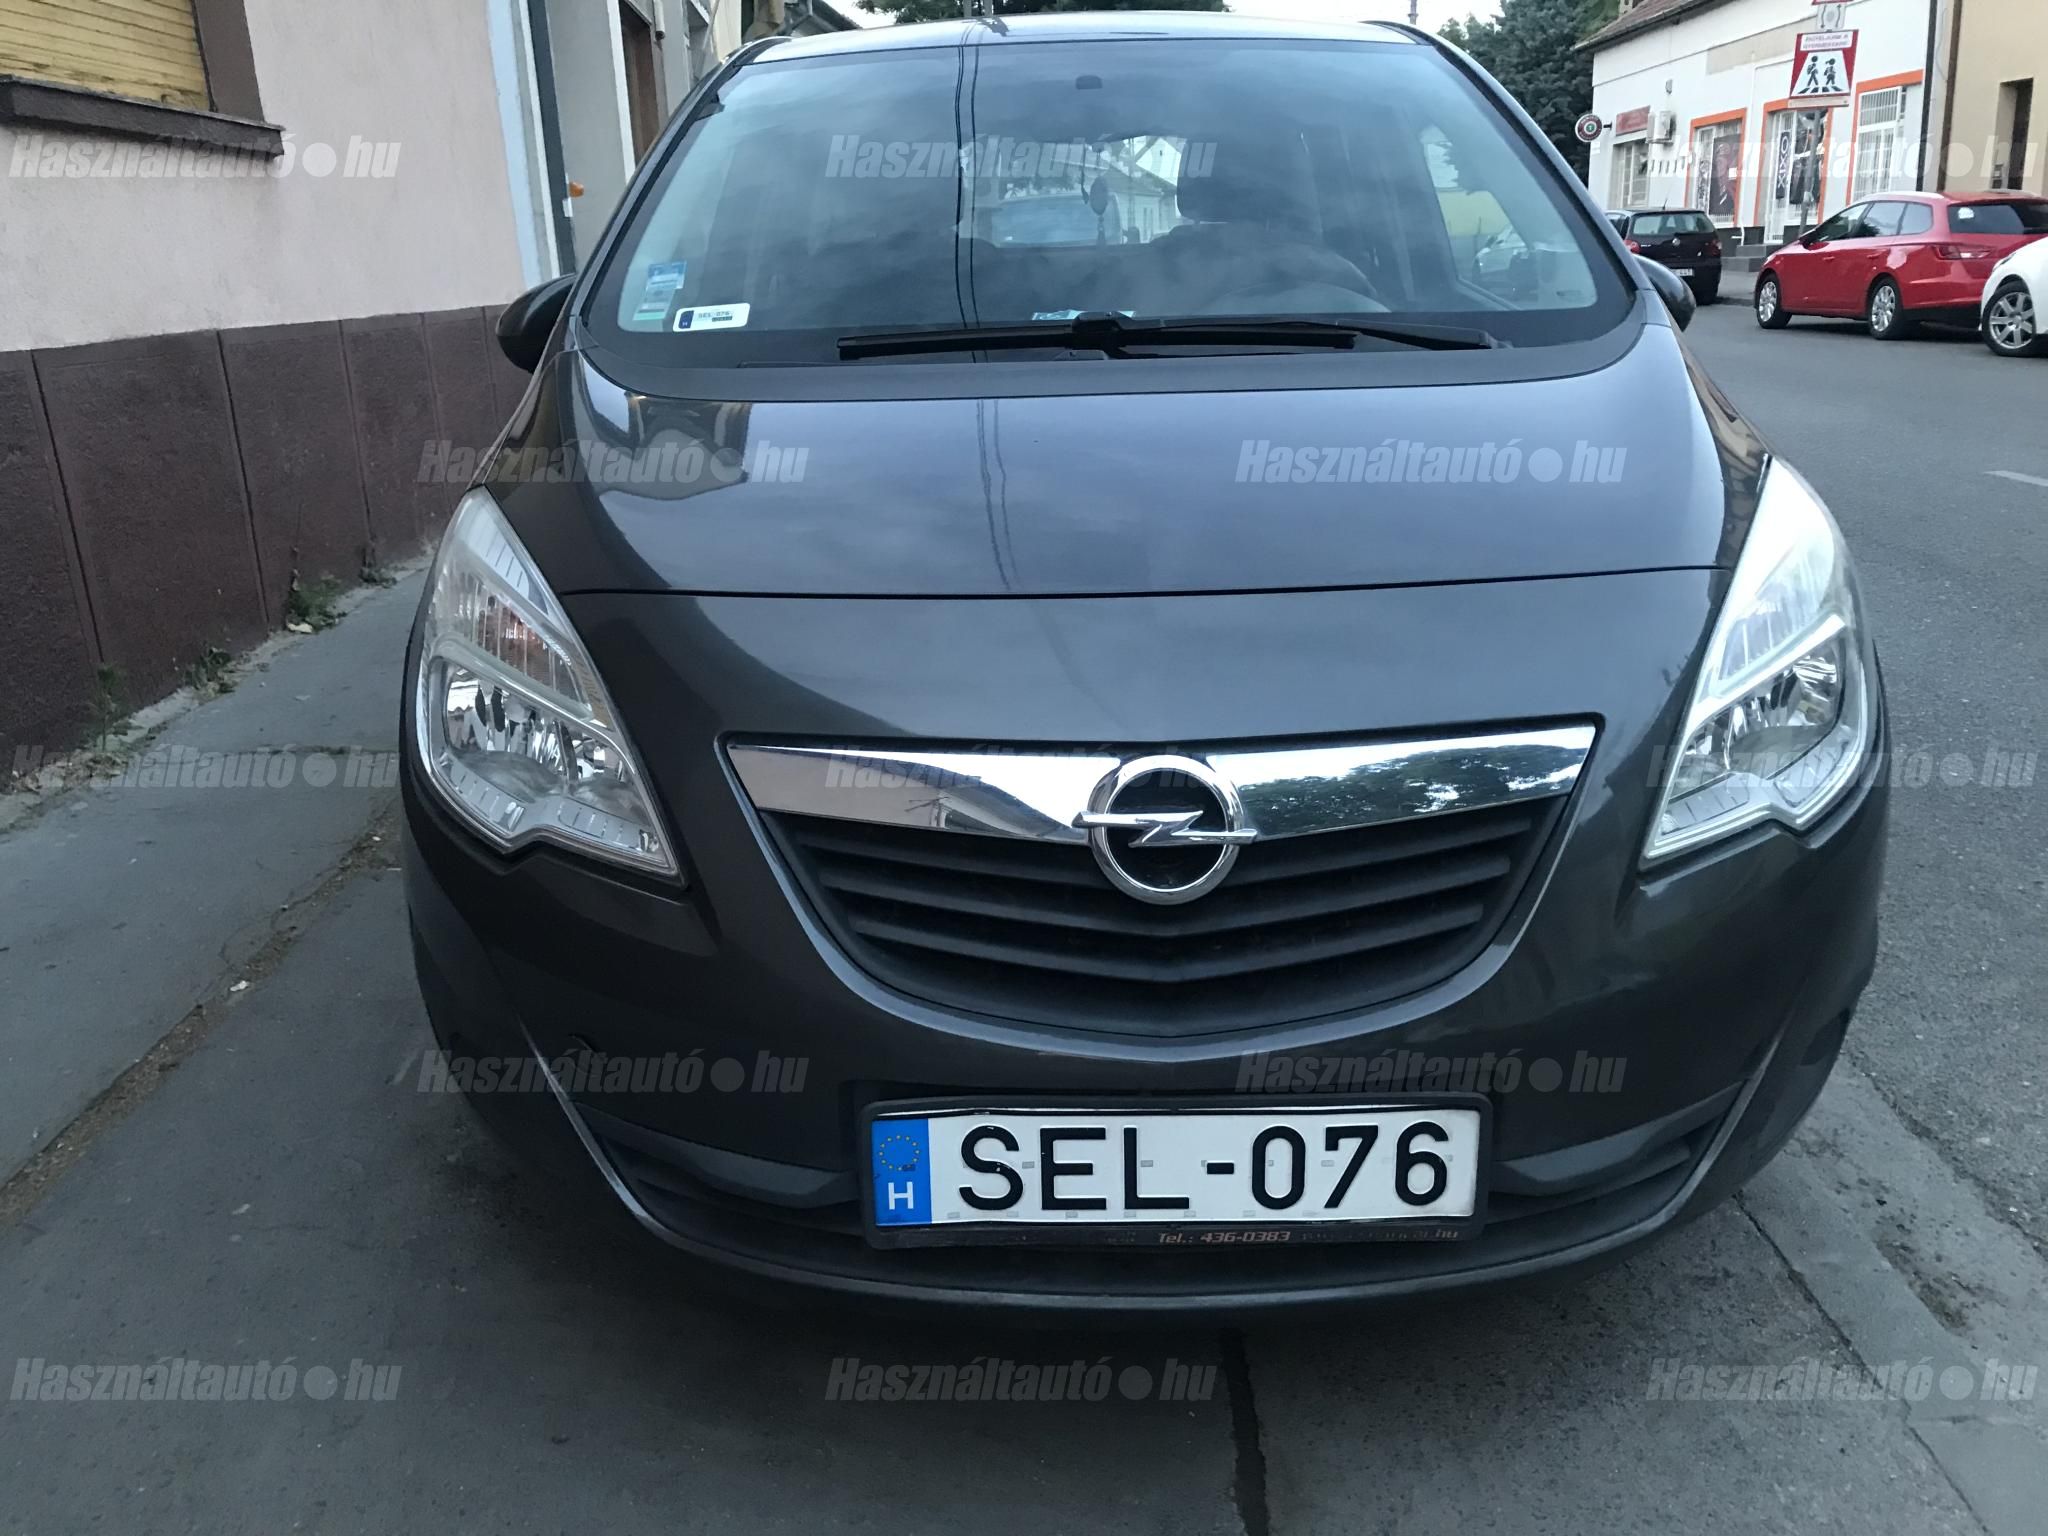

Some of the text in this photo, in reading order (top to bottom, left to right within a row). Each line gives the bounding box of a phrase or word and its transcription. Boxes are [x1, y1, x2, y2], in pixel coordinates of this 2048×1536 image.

[958, 1121, 1450, 1211] SEL-076
[888, 1181, 914, 1210] H
[1200, 1231, 1290, 1243] 436-0383
